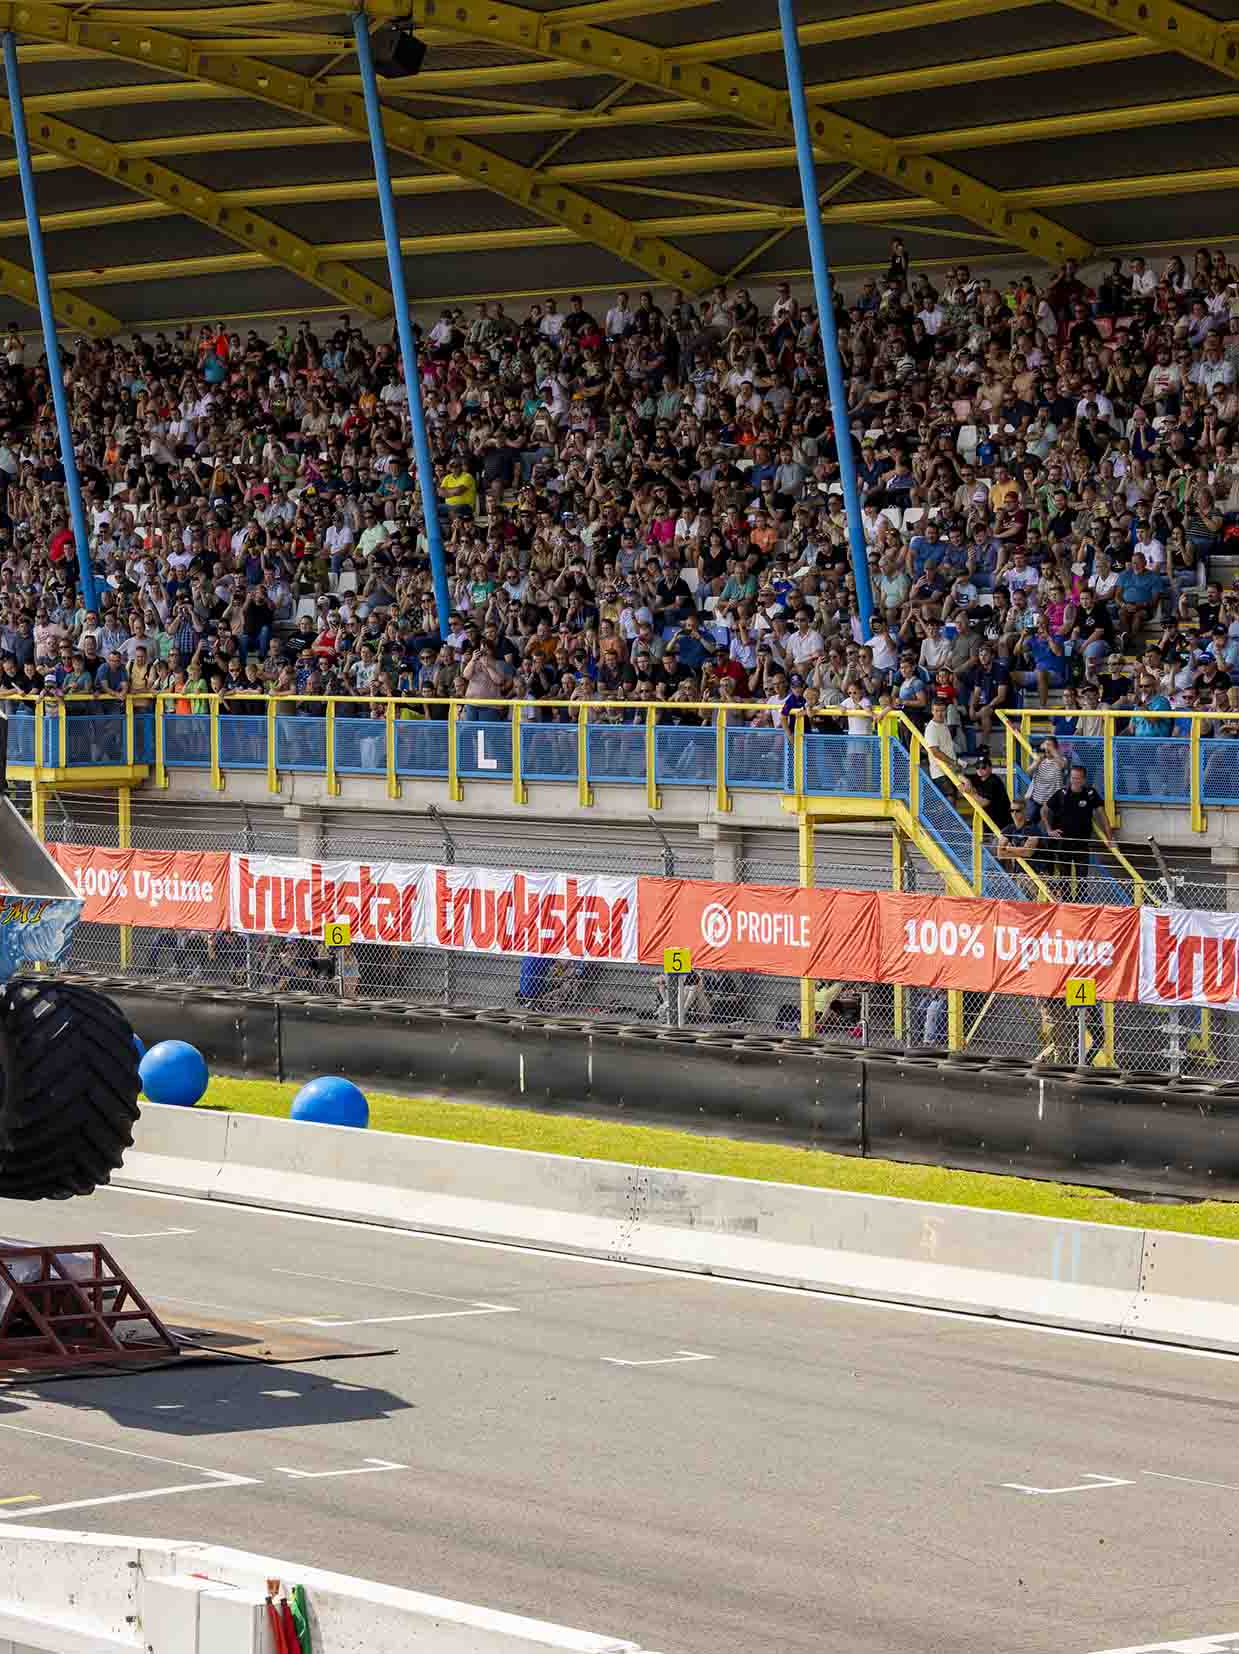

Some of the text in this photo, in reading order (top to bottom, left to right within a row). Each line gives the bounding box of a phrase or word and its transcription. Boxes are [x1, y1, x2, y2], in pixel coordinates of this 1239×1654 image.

[477, 729, 497, 769] L
[74, 865, 215, 907] 100% Uptime
[239, 858, 417, 943] truckstar
[435, 869, 629, 958] truckstar
[736, 910, 811, 948] PROFILE
[332, 926, 343, 945] 6
[903, 919, 1114, 972] 100% Uptime
[672, 952, 682, 972] 5
[1075, 983, 1087, 1004] 4
